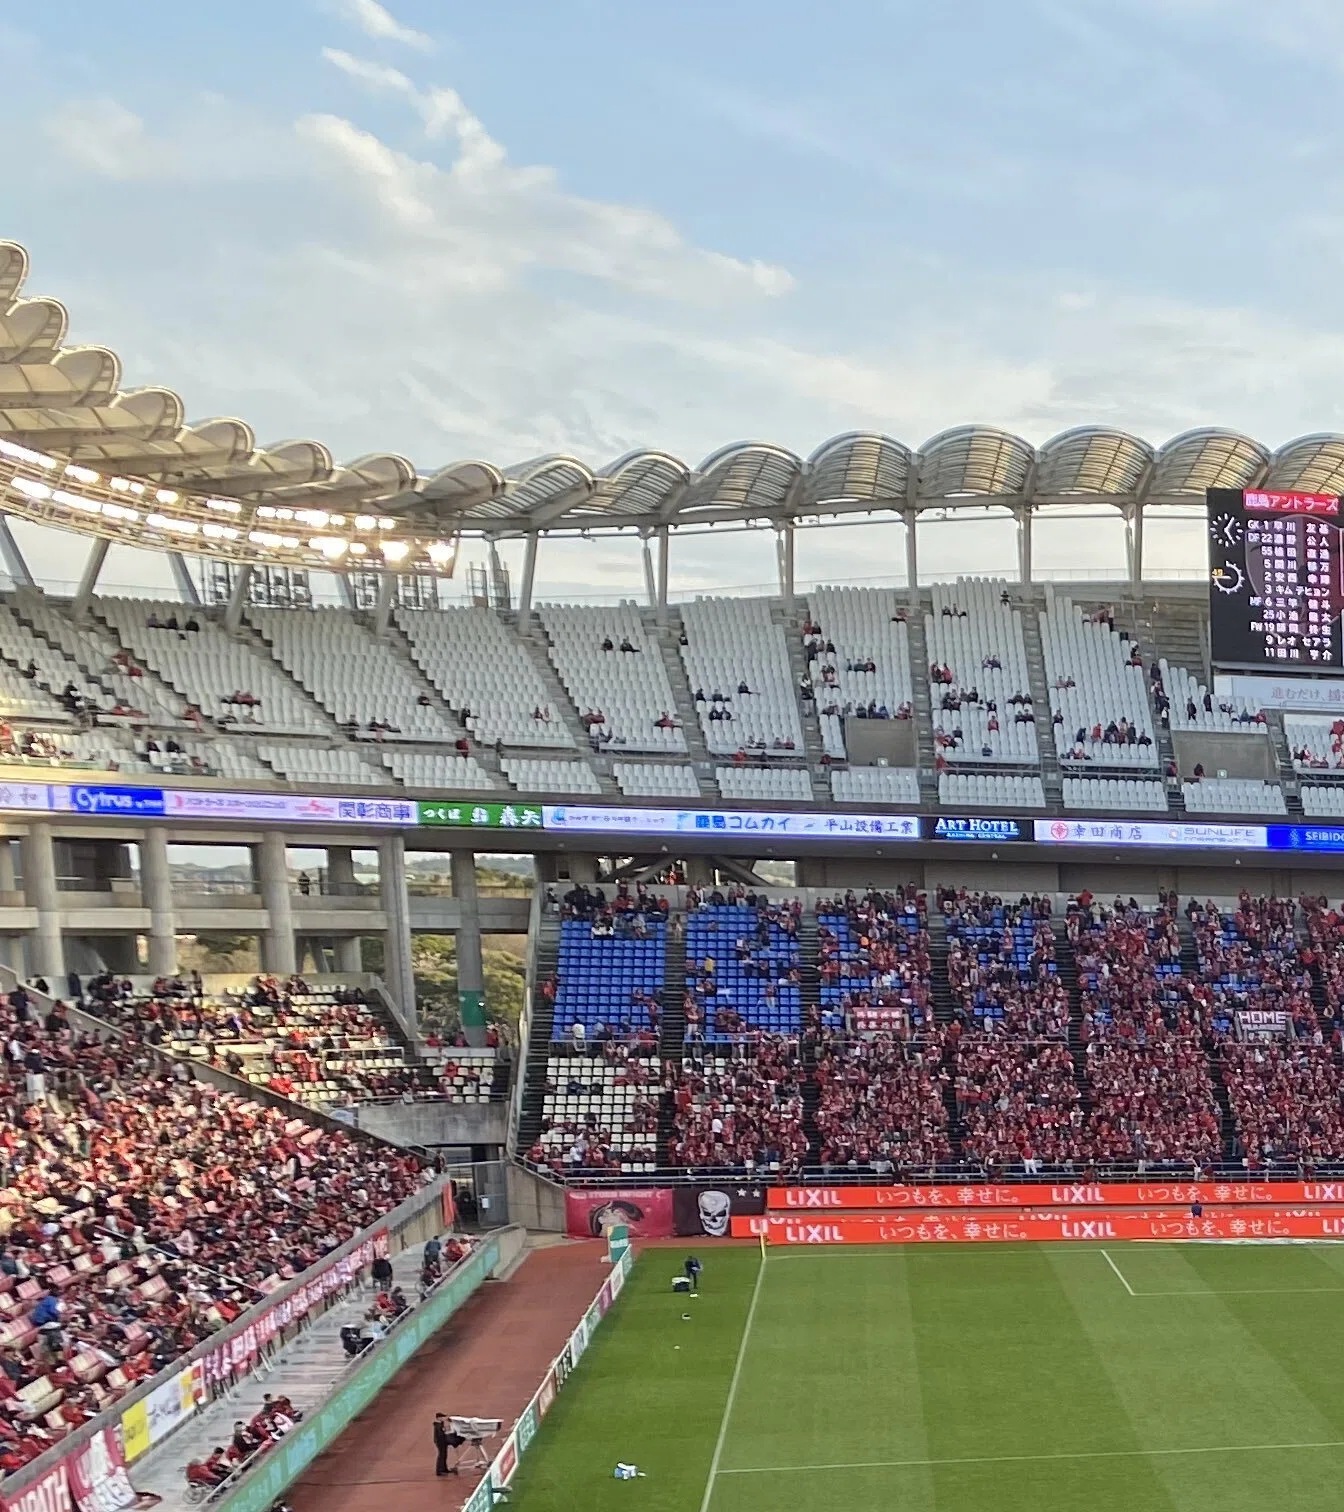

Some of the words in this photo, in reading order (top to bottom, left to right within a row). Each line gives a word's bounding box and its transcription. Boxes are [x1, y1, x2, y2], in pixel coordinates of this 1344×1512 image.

[695, 815, 791, 831] 鹿島コムカイ
[935, 817, 967, 833] ART
[969, 818, 1018, 834] HOTEL
[1183, 826, 1256, 837] SUNLIFE
[1238, 1011, 1287, 1024] HOME
[786, 1189, 842, 1205] LIXIL
[1052, 1186, 1105, 1202] LIXIL
[786, 1225, 843, 1242] LIXIL
[1061, 1221, 1116, 1238] LIXIL
